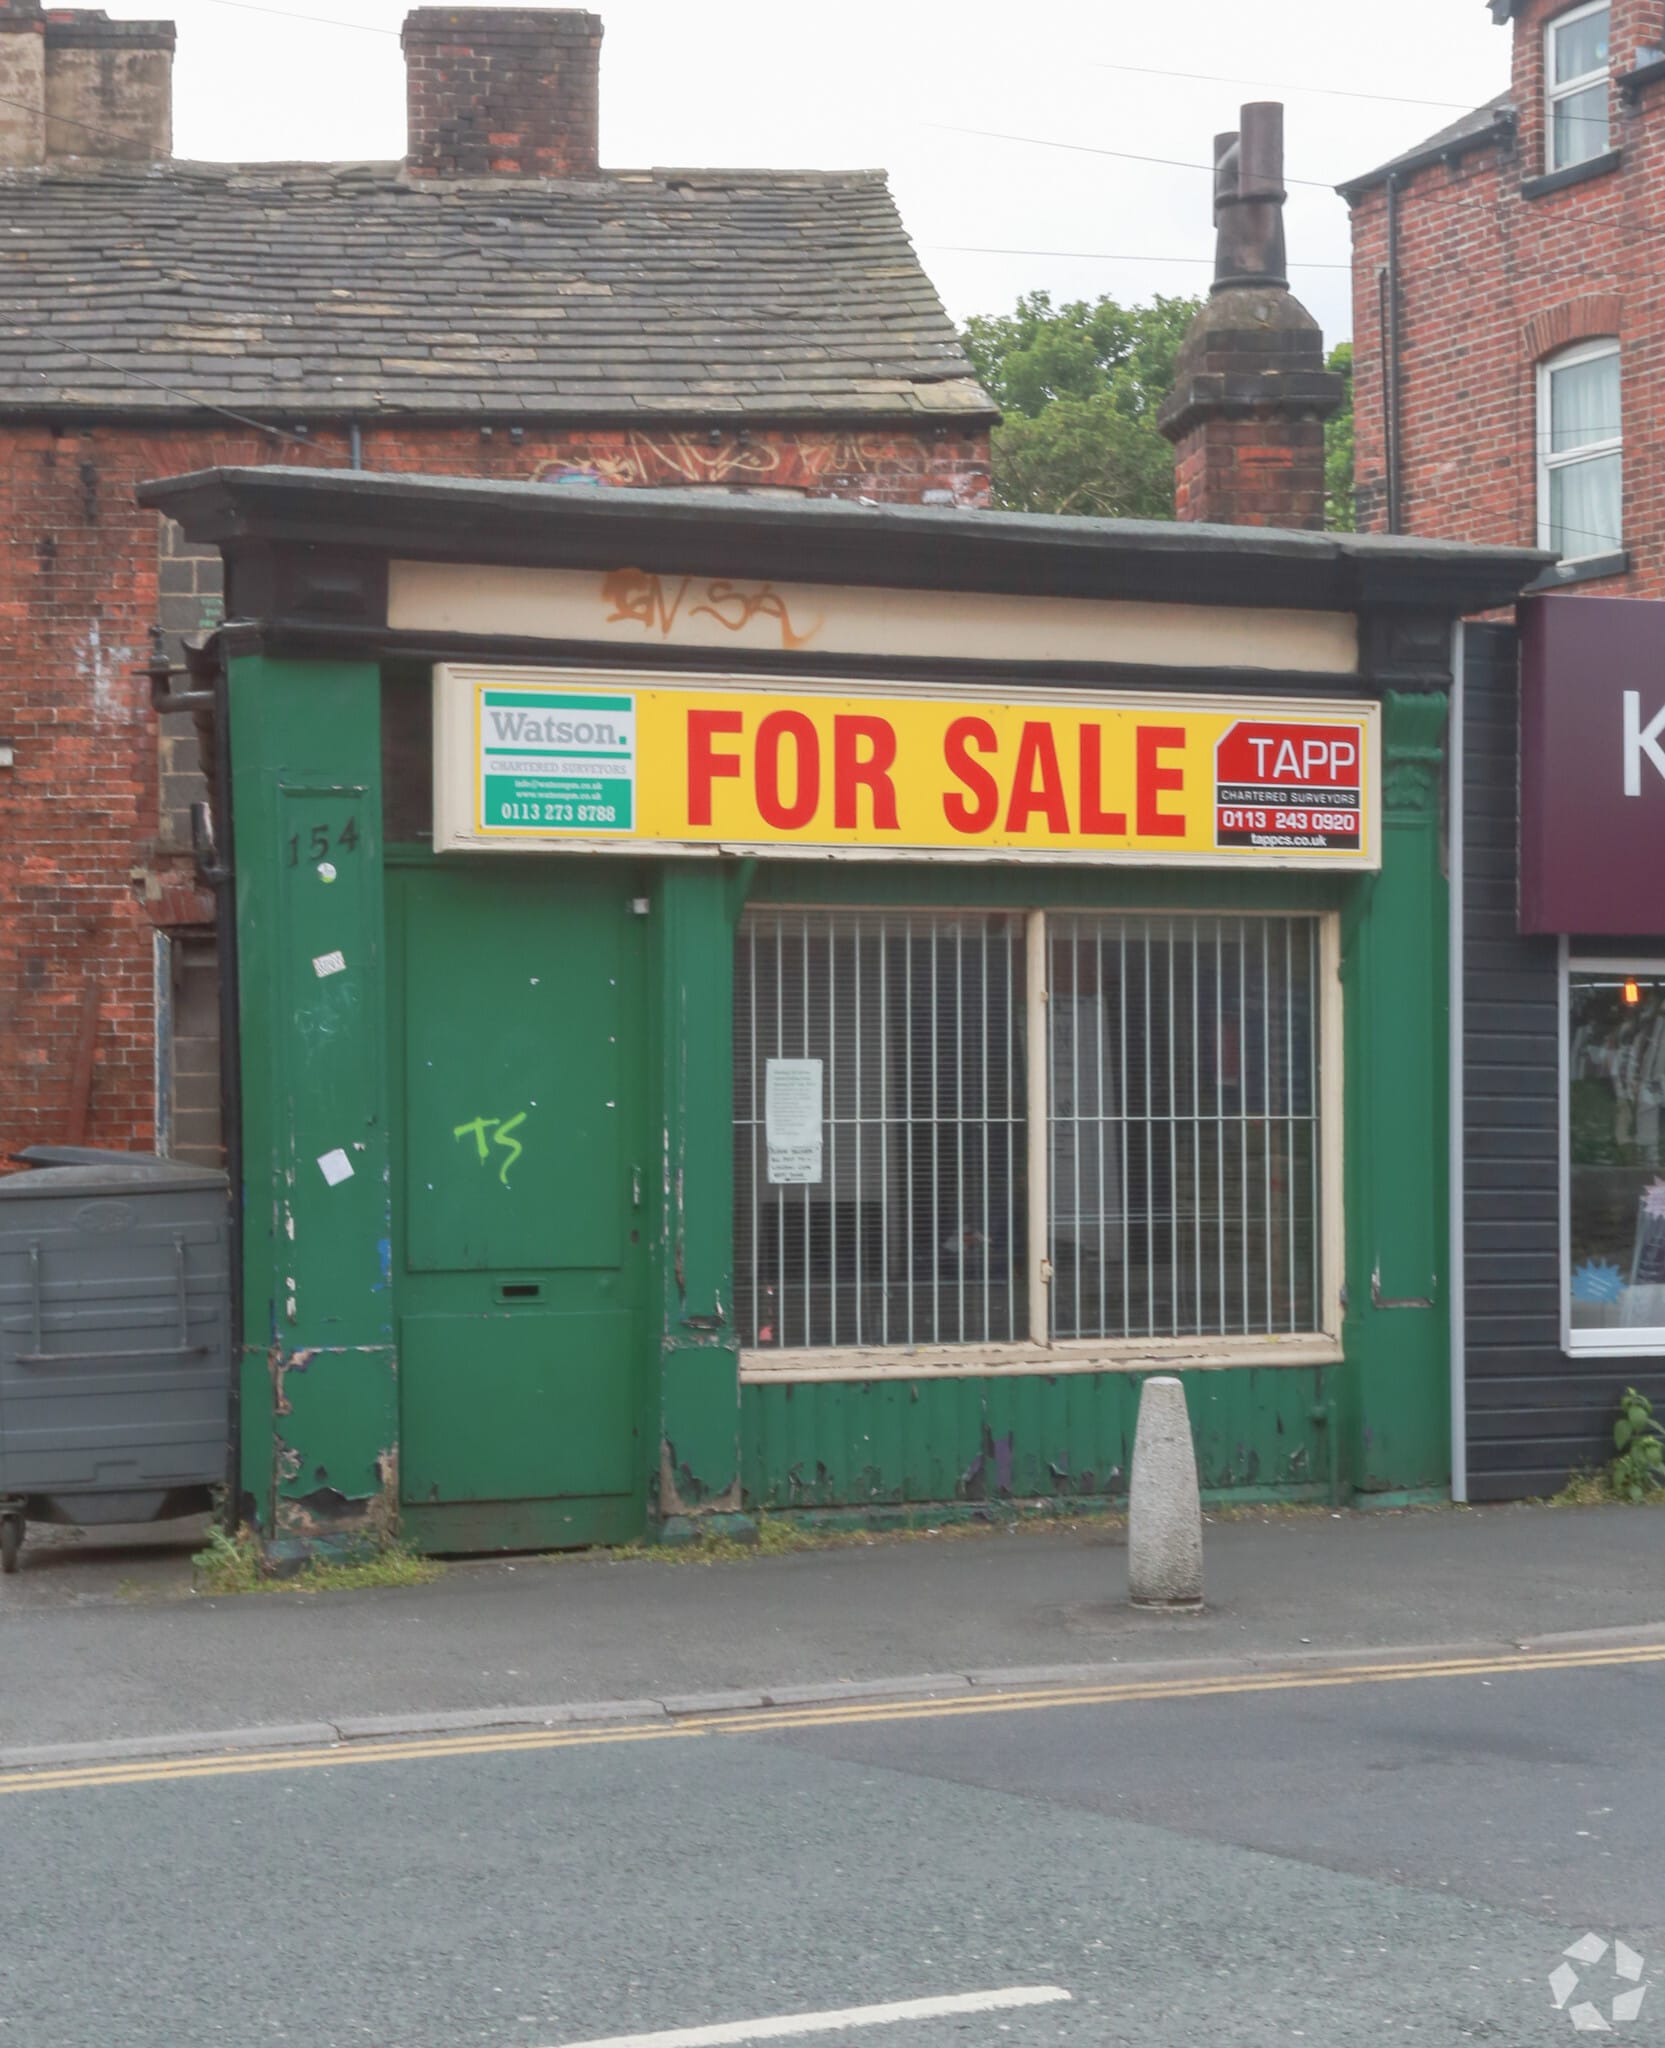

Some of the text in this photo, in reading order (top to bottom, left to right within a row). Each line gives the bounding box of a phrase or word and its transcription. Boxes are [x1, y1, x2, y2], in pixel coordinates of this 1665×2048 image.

[489, 711, 627, 745] Watson.
[490, 761, 627, 775] CHARTERED SURVEYORS
[1247, 737, 1356, 780] TAPP
[687, 709, 1186, 837] FOR SALE
[1221, 789, 1356, 805] CHARTERED SURVEYORS
[501, 802, 616, 822] 0113 273 8788
[1222, 810, 1356, 831] 0113 243 0920
[287, 815, 360, 868] 154
[1250, 832, 1328, 848] tappcs.co.uk
